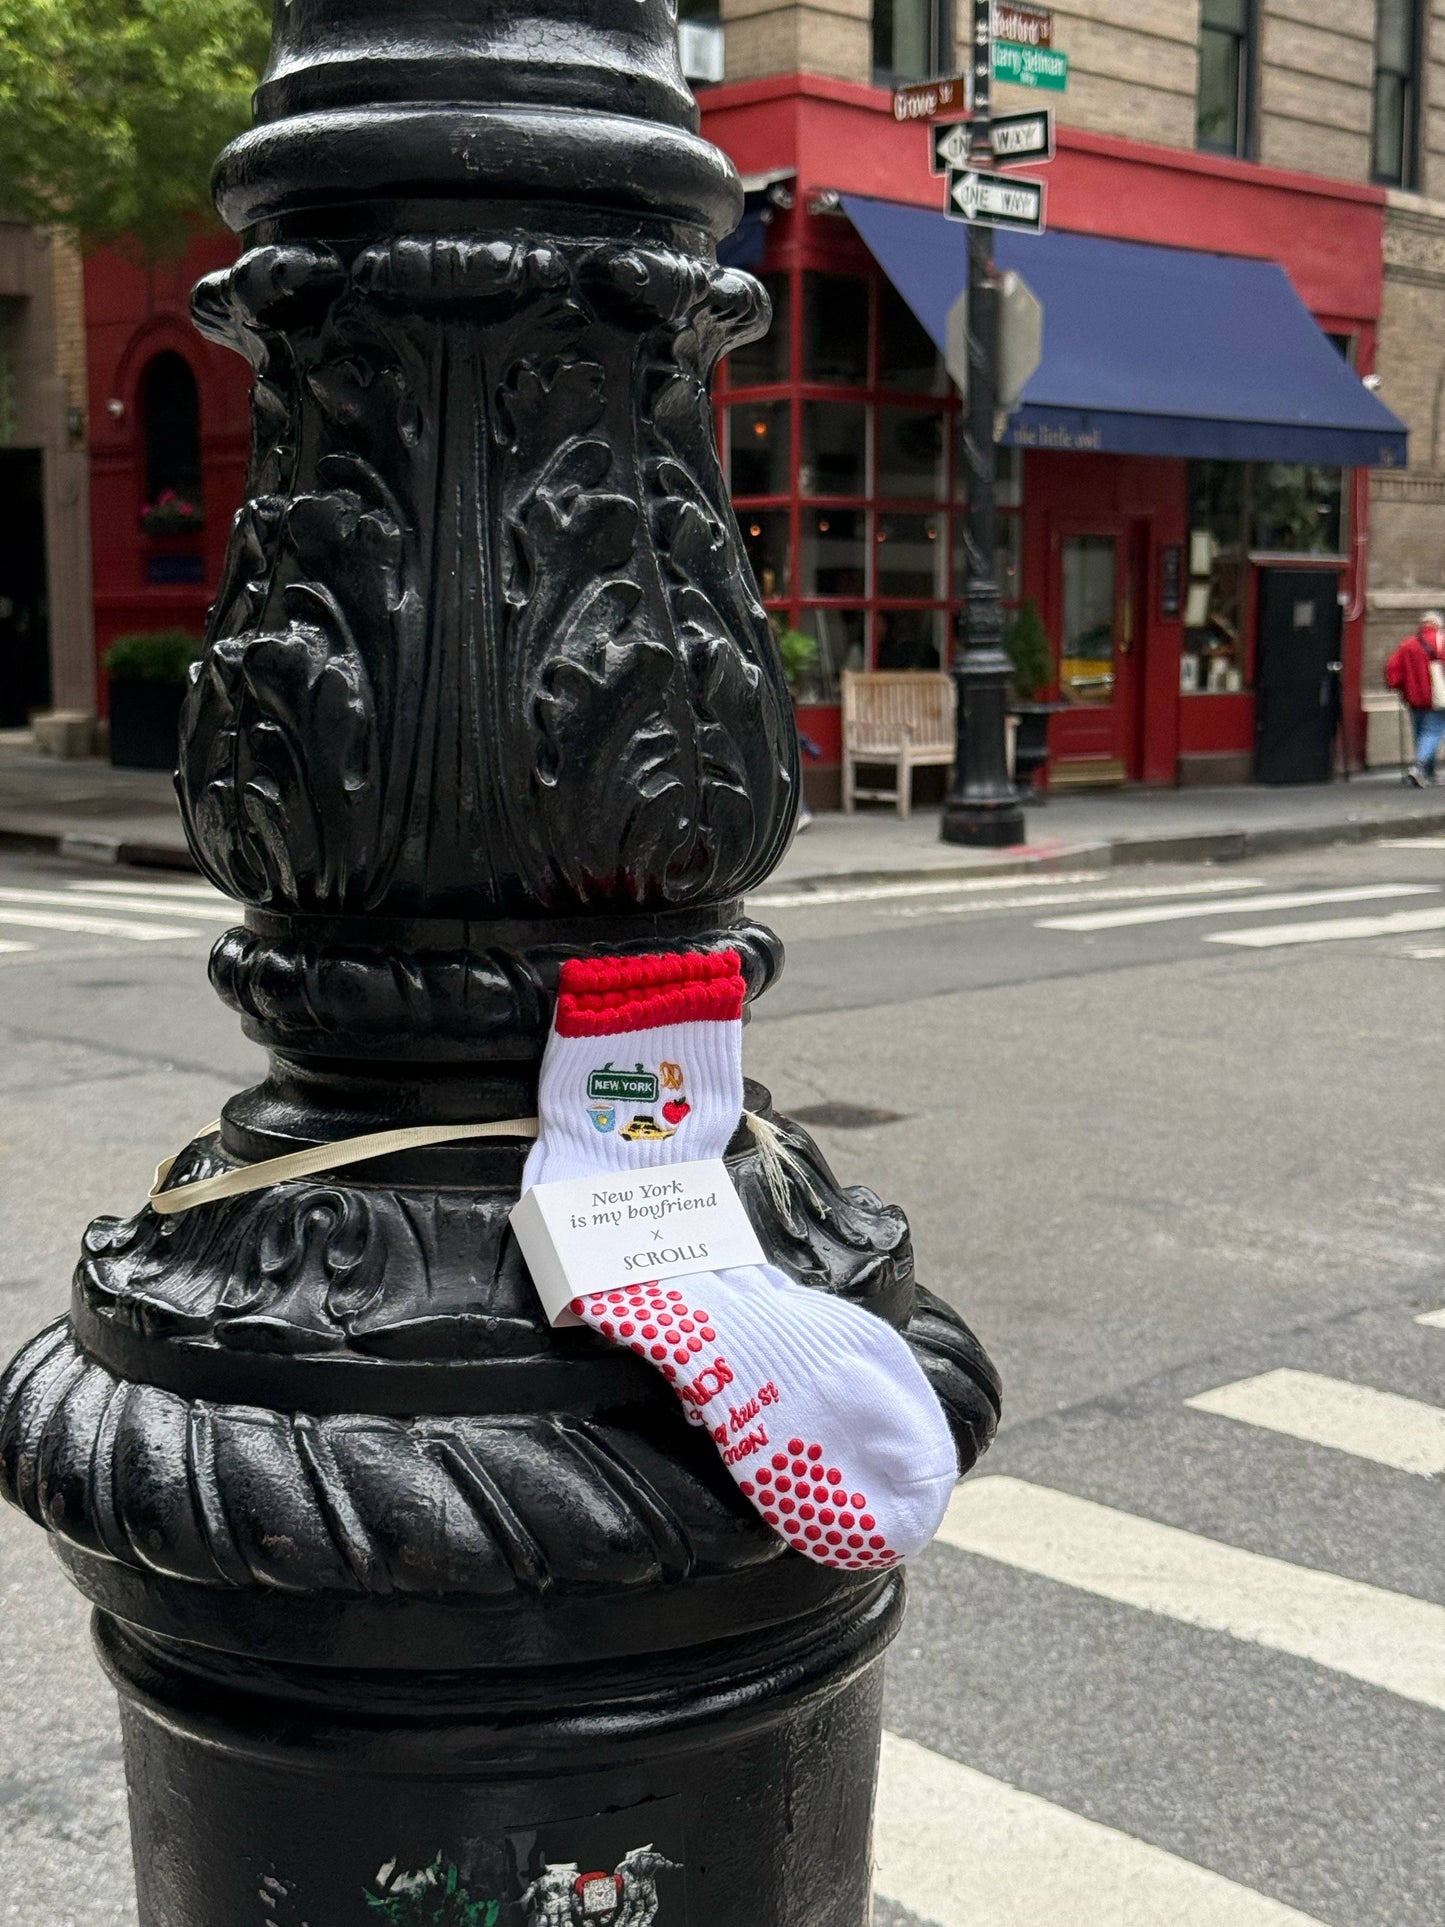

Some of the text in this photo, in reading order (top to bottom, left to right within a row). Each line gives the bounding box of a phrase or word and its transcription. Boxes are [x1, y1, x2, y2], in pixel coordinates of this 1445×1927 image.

[992, 8, 1039, 45] Bedford
[894, 90, 937, 121] Grove
[997, 126, 1036, 150] WAY
[961, 185, 1033, 214] ONE WAY
[1039, 423, 1073, 447] little
[1074, 428, 1101, 449] owl
[594, 1079, 654, 1093] NEW YORK
[592, 1180, 684, 1207] New York
[570, 1193, 718, 1228] is my boyfriend
[623, 1243, 709, 1271] SCROLLS
[758, 1381, 779, 1406] is
[729, 1398, 760, 1433] my
